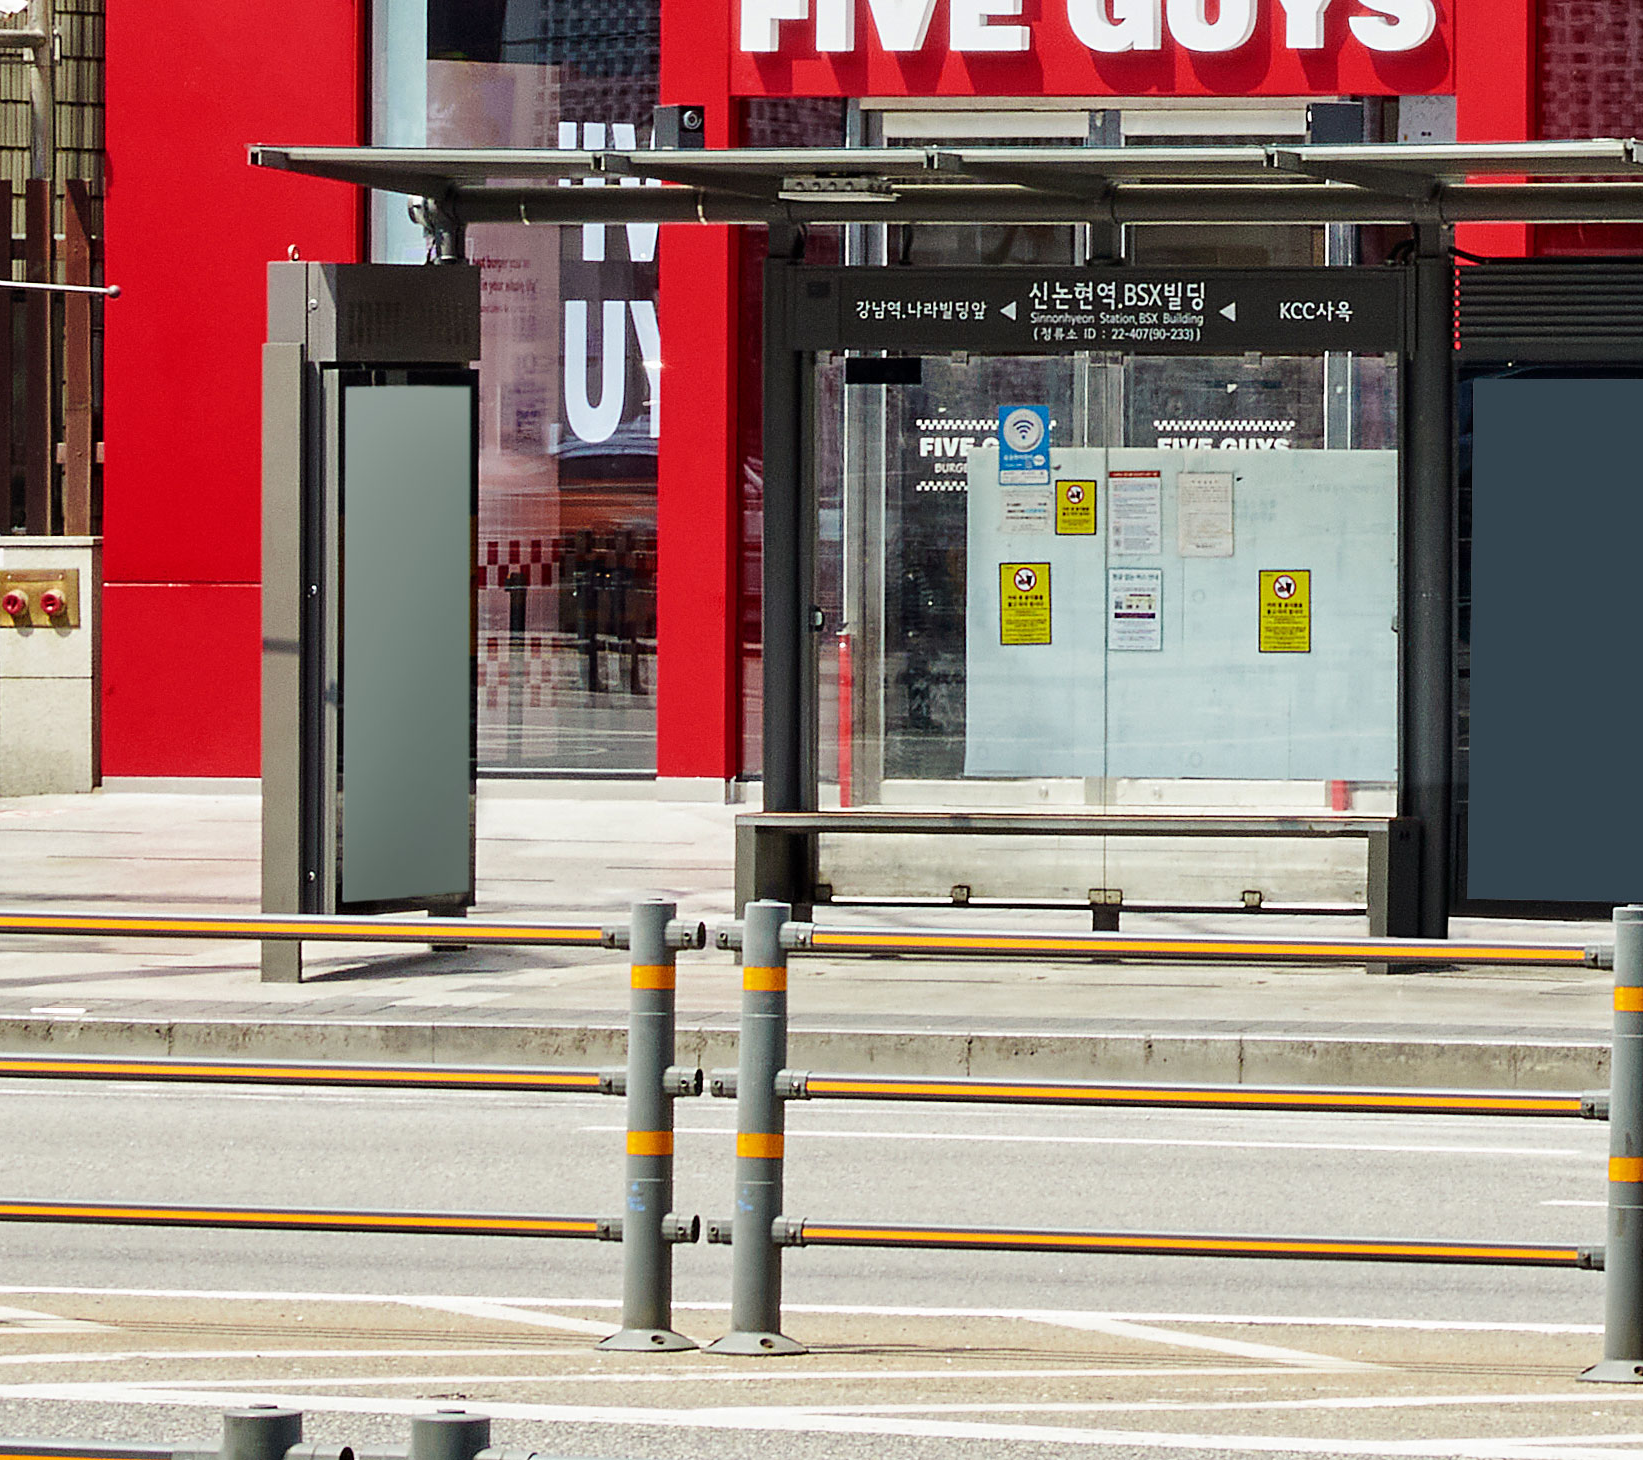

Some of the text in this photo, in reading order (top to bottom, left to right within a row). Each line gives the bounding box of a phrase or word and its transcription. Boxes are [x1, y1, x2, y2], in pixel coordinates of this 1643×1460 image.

[1028, 281, 1206, 312] 신논현역.BSX빌딩
[855, 300, 988, 321] 강남역.나라빌딩앞
[1030, 312, 1095, 327] Sinnonhyeon
[1162, 311, 1204, 328] Building
[1279, 301, 1354, 323] KCC사옥
[1083, 328, 1097, 340] ID
[919, 437, 976, 458] FIVE
[1157, 437, 1291, 450] FIVE GUYS
